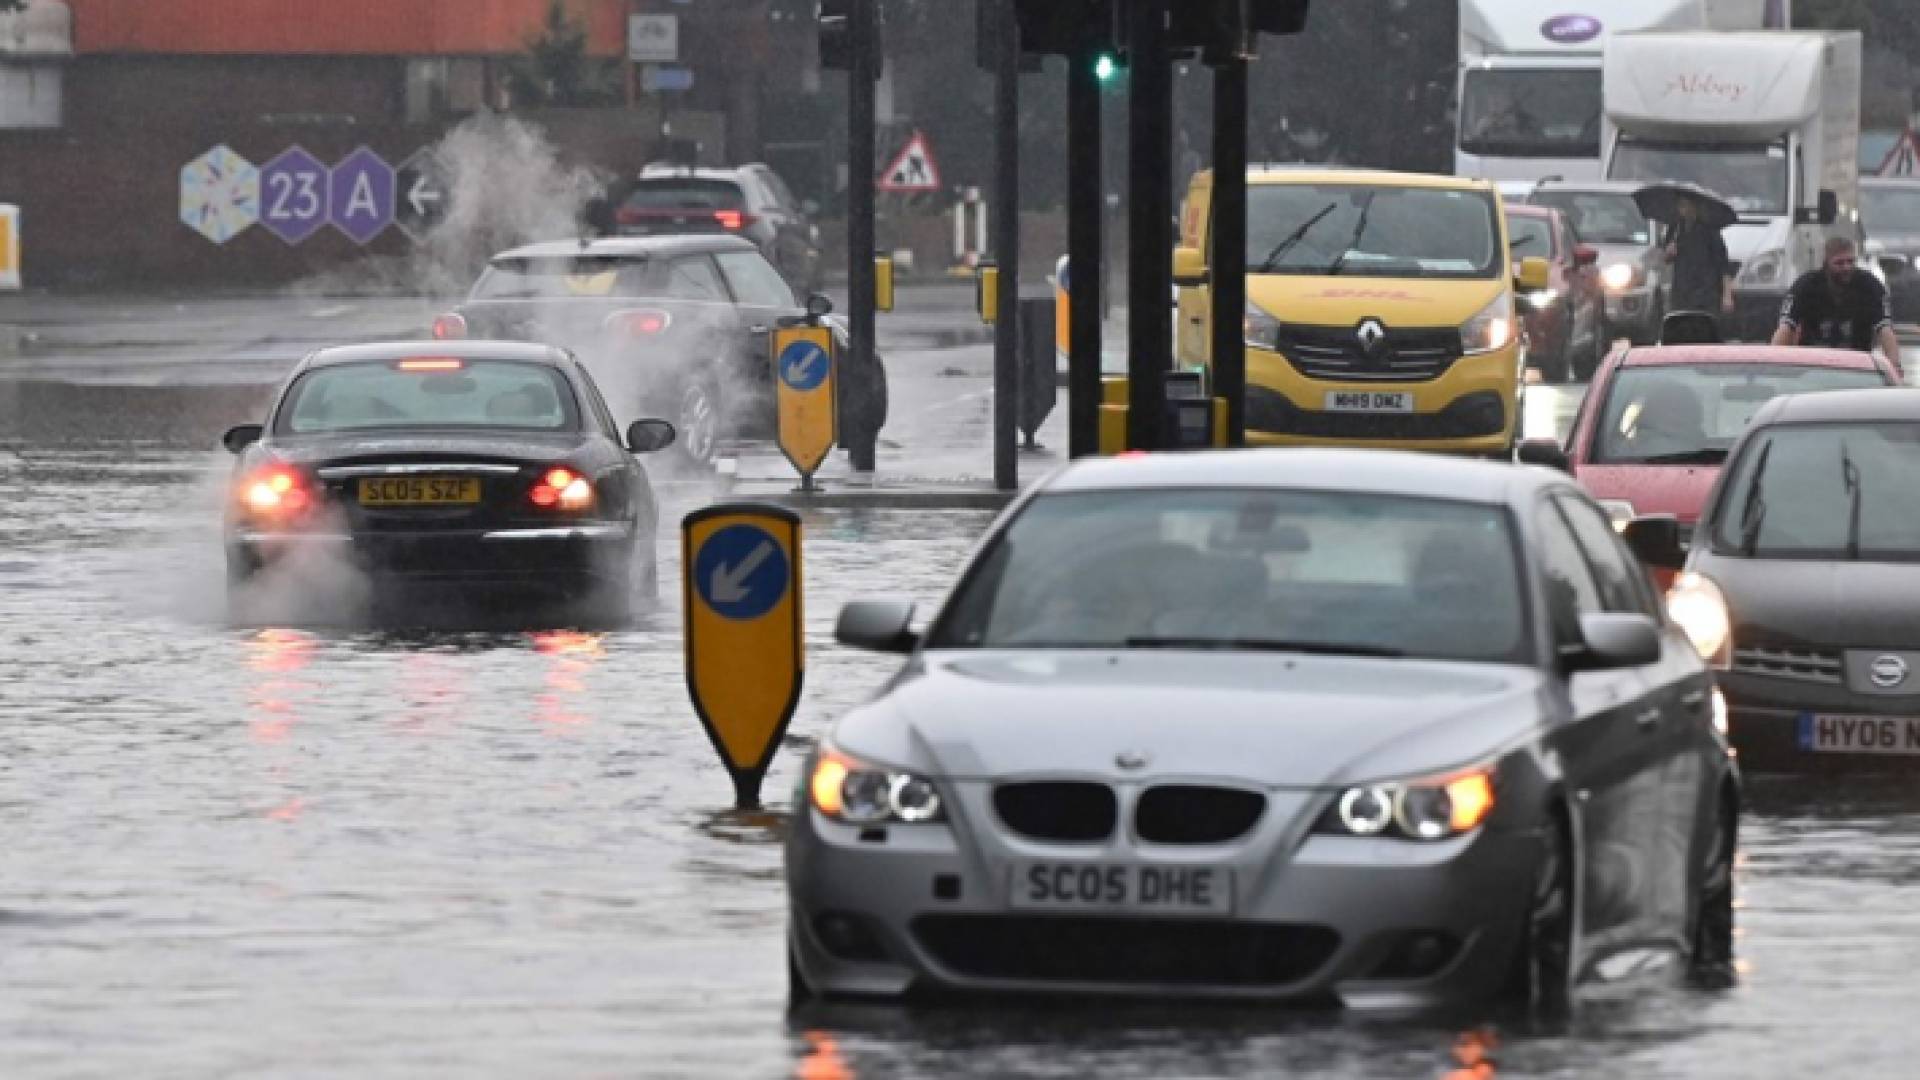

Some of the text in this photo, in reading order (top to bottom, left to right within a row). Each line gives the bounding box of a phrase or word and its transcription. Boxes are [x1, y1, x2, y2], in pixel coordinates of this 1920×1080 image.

[269, 170, 379, 219] 23 A
[366, 480, 473, 500] SC05 SZF
[1819, 719, 1897, 747] HY06
[1028, 865, 1213, 904] SC05 DHE
